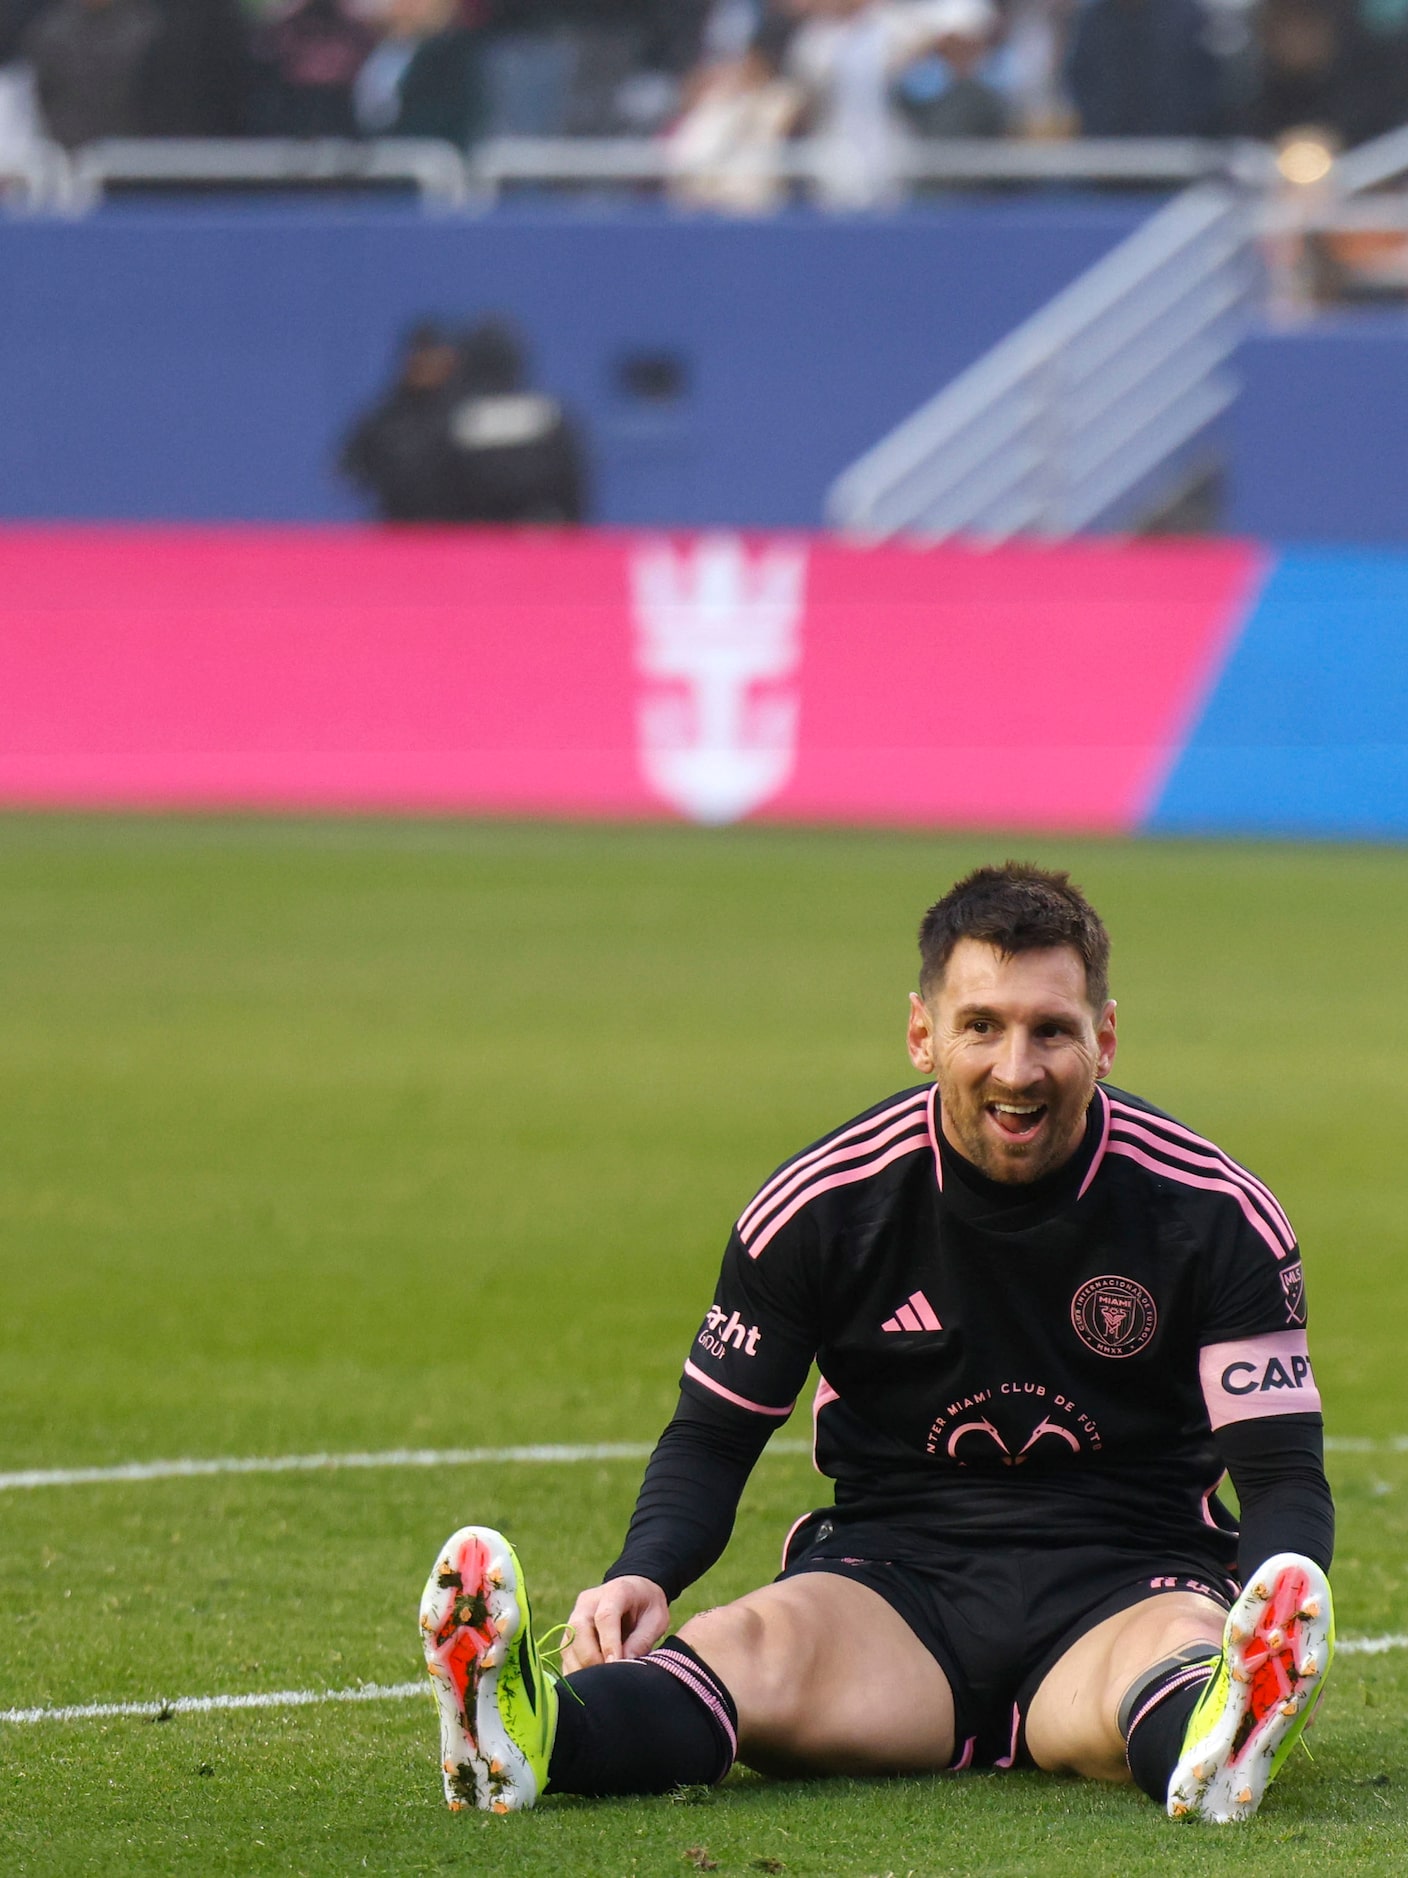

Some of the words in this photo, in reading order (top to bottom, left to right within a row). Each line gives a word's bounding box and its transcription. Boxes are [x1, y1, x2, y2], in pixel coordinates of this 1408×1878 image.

[1284, 1268, 1301, 1286] MLS
[1076, 1279, 1142, 1307] INTERNACIONAL
[1098, 1296, 1133, 1308] MIAMI
[1096, 1343, 1123, 1354] MMXX
[1221, 1355, 1311, 1395] CAP
[926, 1416, 947, 1454] NTER
[946, 1388, 992, 1416] MIAMI
[1000, 1382, 1046, 1396] CLUB
[1053, 1394, 1076, 1413] DE
[1077, 1413, 1102, 1450] FÚTB
